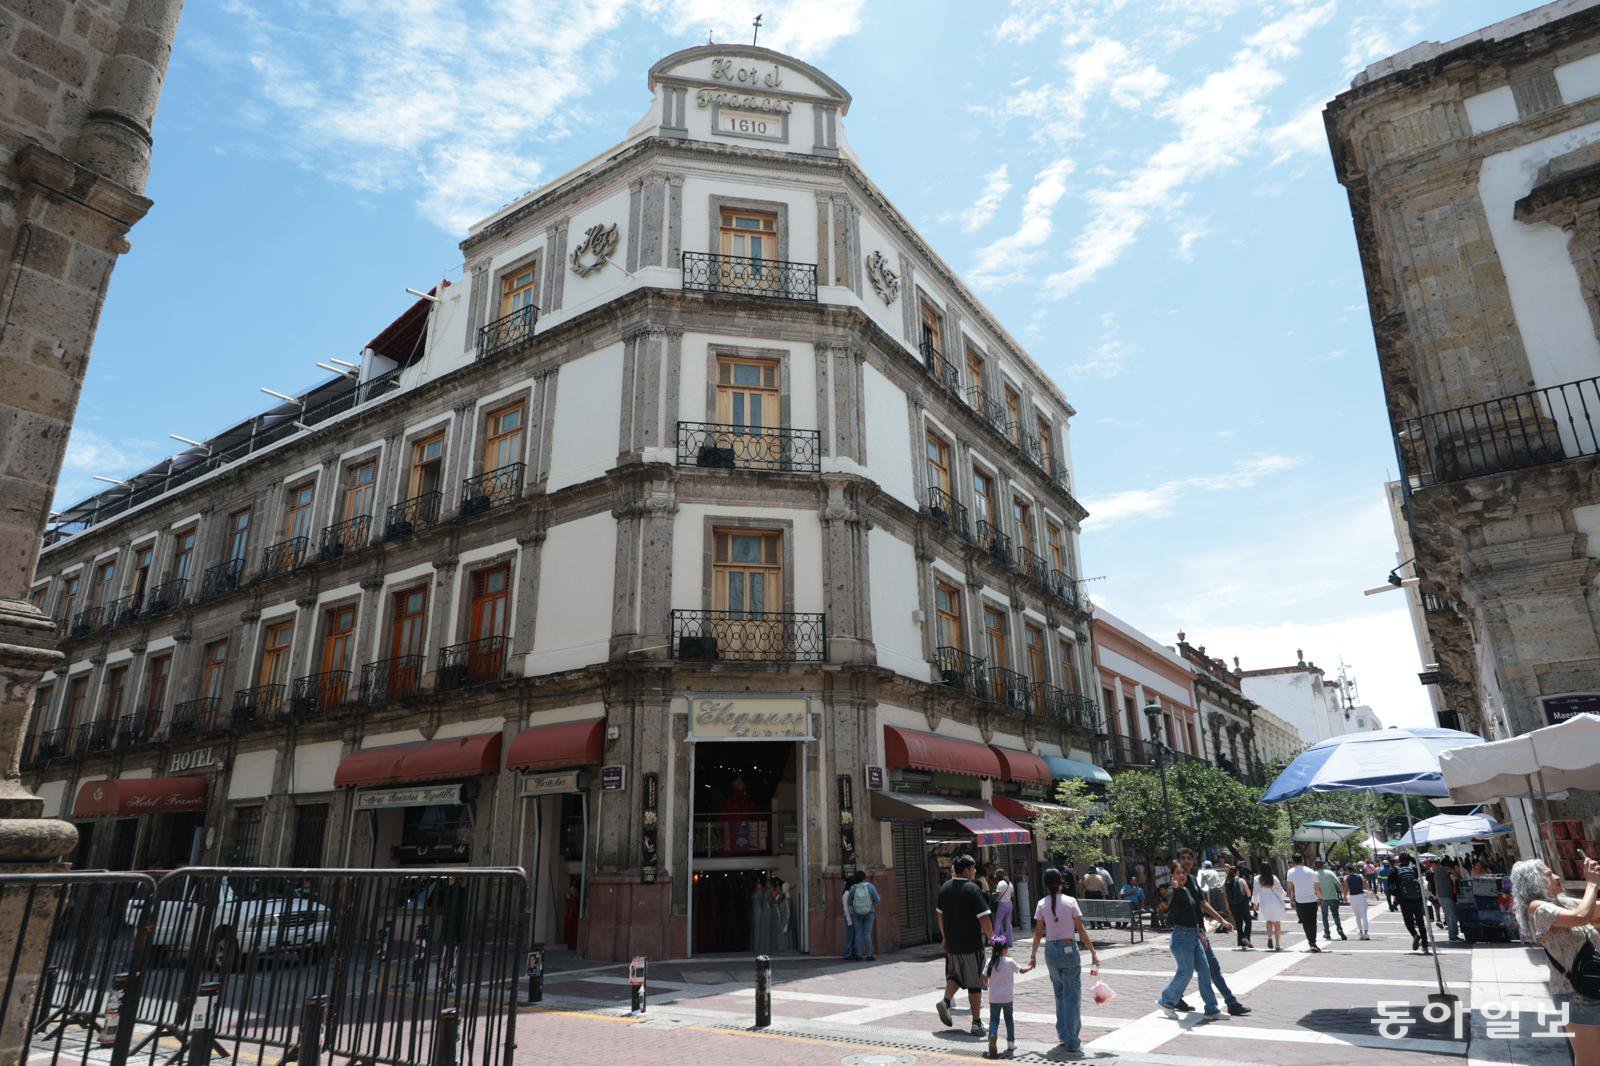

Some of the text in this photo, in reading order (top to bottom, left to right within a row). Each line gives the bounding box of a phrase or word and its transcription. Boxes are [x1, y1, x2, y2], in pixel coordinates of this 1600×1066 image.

[711, 57, 783, 88] Hotel
[730, 118, 767, 134] 1610
[1553, 710, 1600, 720] Maestza
[169, 747, 215, 772] HOTEL
